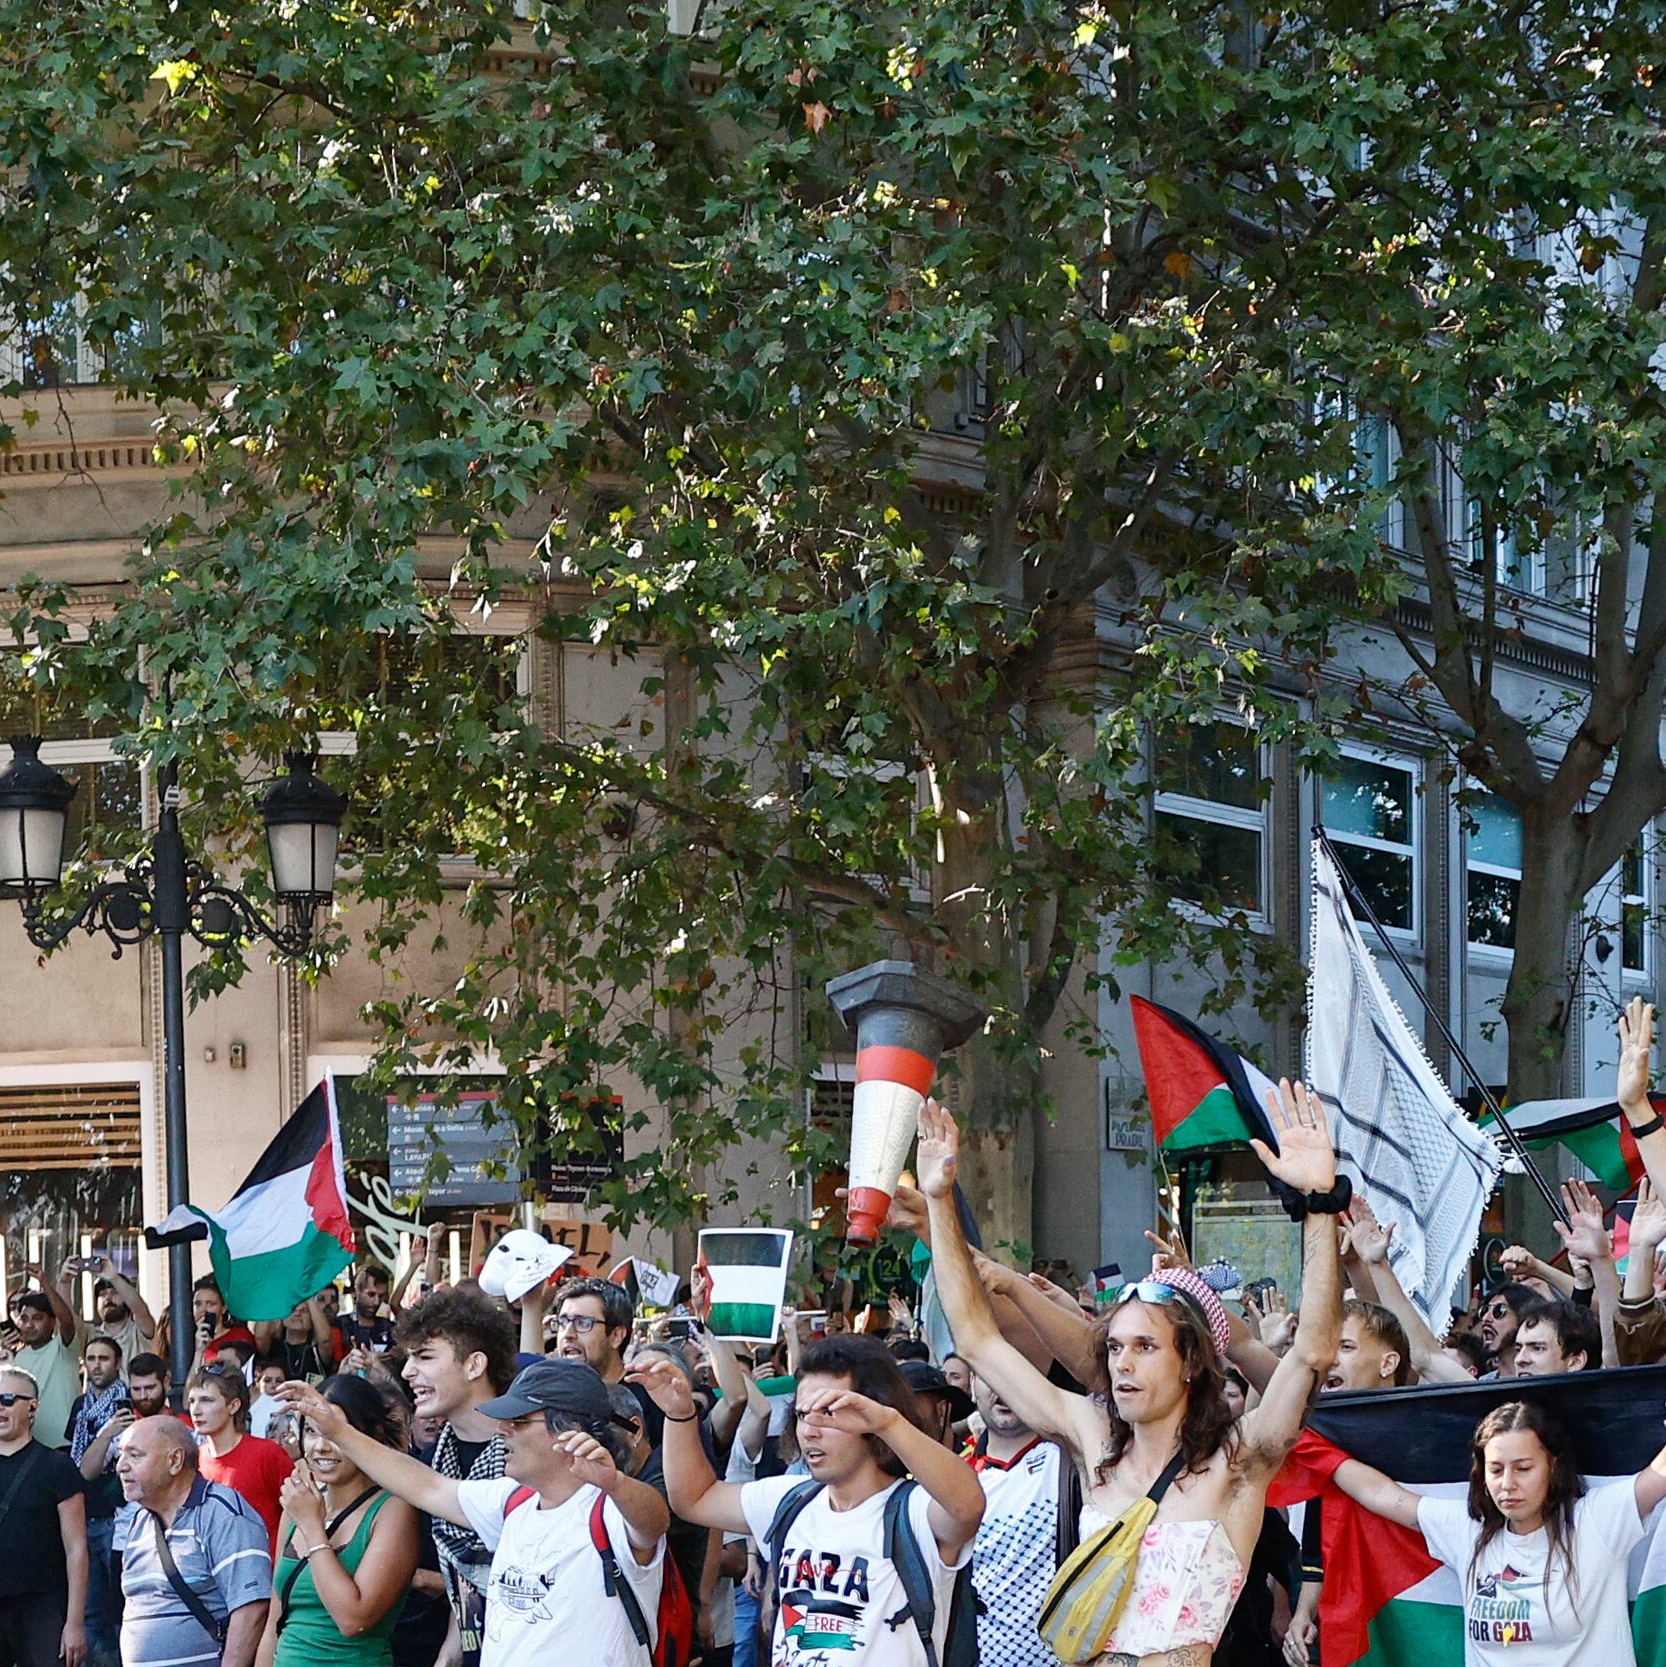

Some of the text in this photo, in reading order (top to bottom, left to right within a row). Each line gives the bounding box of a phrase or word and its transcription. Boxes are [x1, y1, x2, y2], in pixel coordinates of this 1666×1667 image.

[1470, 1596, 1531, 1620] FREEDOM
[814, 1616, 844, 1632] FREE
[1469, 1618, 1490, 1642] FOR
